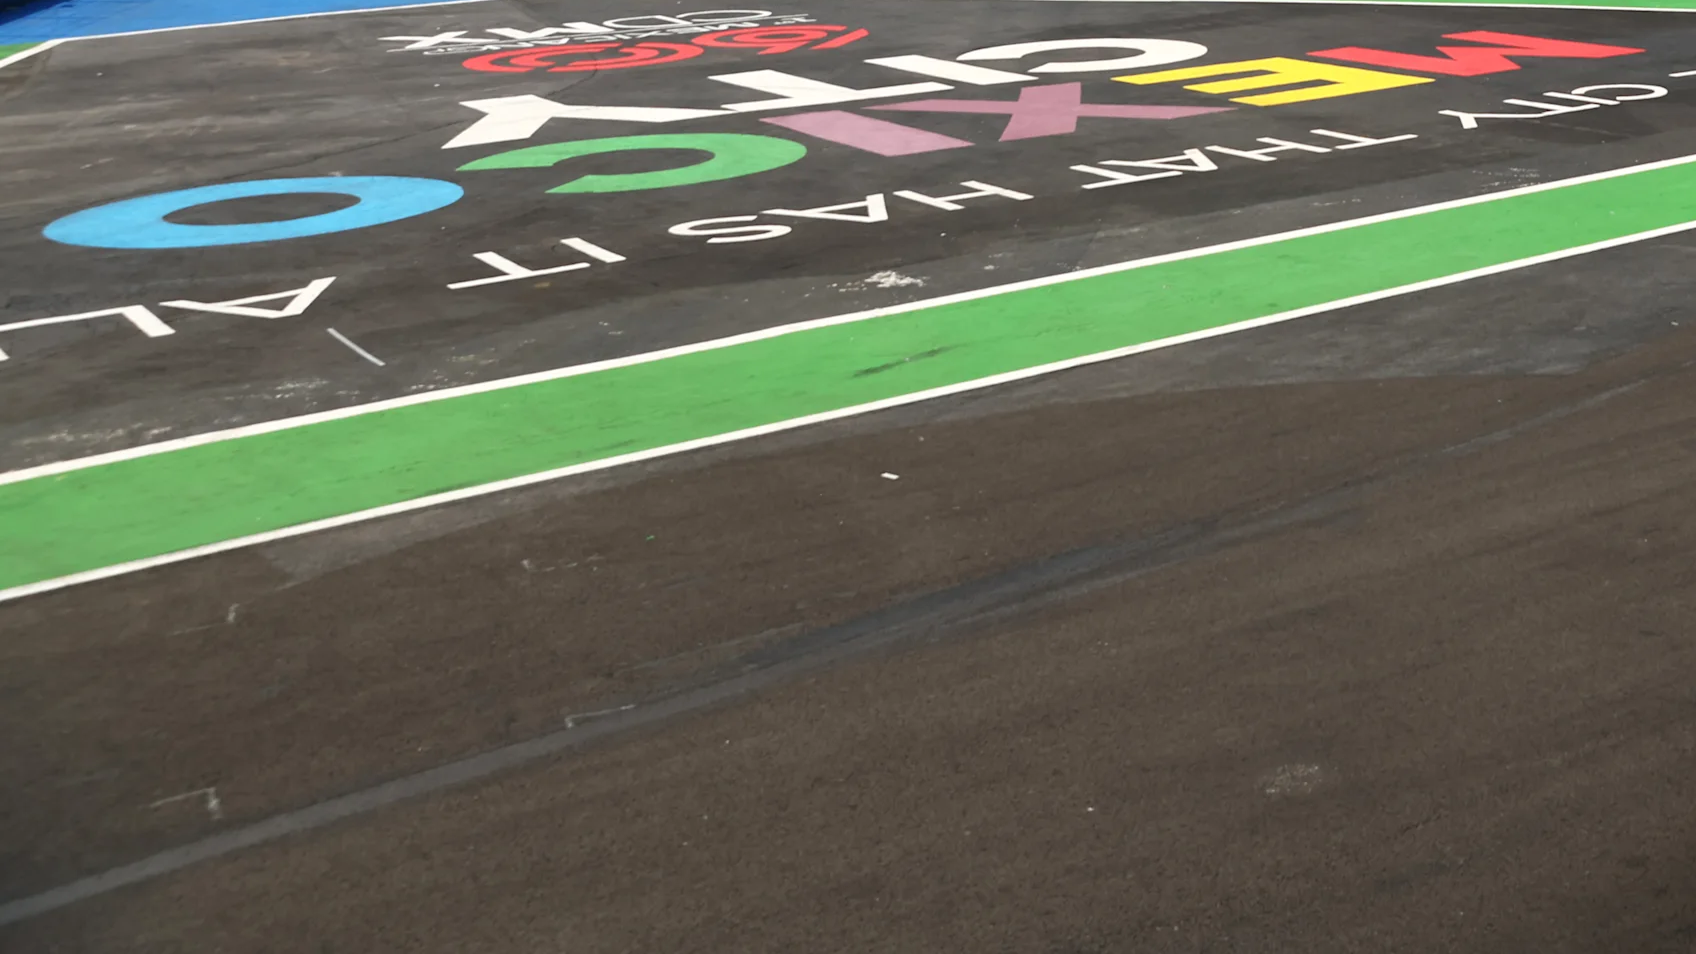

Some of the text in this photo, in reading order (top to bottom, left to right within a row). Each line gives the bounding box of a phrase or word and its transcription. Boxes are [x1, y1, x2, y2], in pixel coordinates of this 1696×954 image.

[378, 9, 773, 51] CDMX
[441, 38, 1208, 150] CITY
[1439, 83, 1668, 129] CITY
[42, 30, 1647, 249] MEXICO
[1069, 129, 1418, 190] THAT
[667, 181, 1033, 244] HAS
[447, 238, 627, 290] IT
